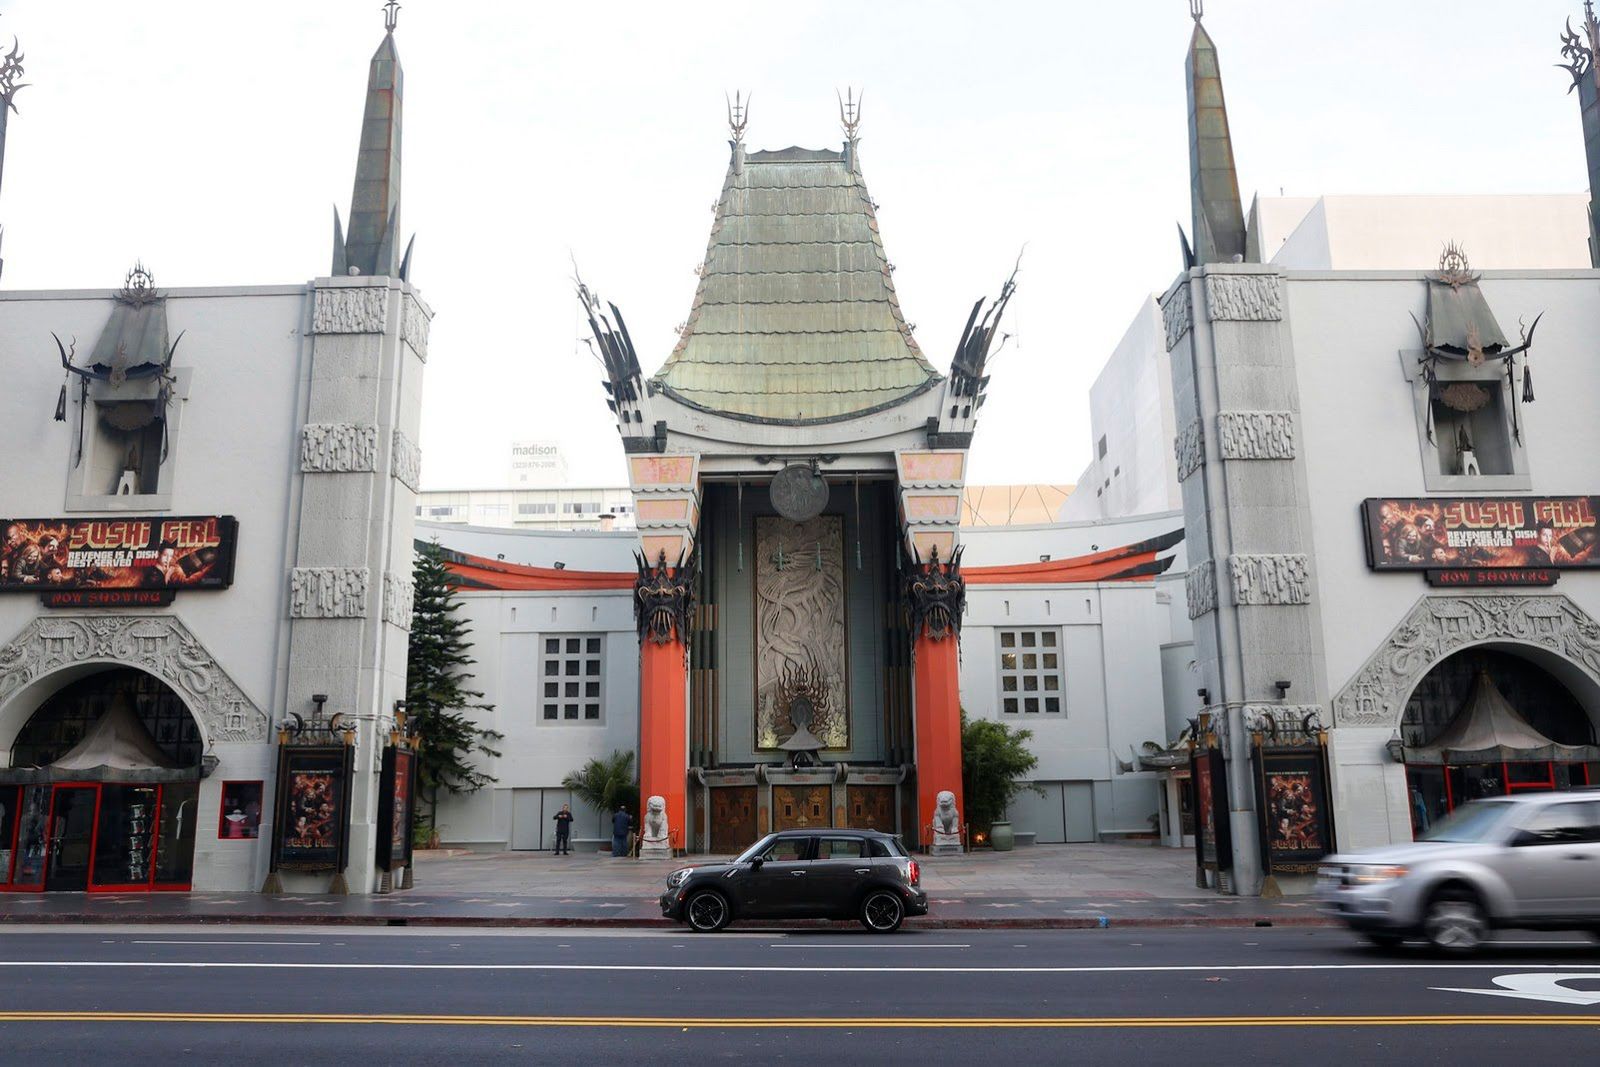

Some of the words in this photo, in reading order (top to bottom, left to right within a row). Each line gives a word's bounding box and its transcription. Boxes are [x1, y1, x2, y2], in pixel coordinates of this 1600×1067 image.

[512, 444, 557, 455] madison
[1447, 531, 1493, 540] REVENGE
[1494, 531, 1504, 540] IS
[1506, 531, 1513, 539] A
[1515, 530, 1537, 539] DISH
[1448, 538, 1472, 547] BEST
[1475, 538, 1513, 547] SERVED
[68, 551, 114, 560] REVENGE
[115, 551, 124, 559] IS
[126, 551, 133, 559] A
[136, 550, 159, 559] DISH
[67, 559, 93, 568] BEST
[95, 558, 132, 567] SERVED
[1440, 572, 1469, 583] NOW
[1477, 571, 1549, 583] SHOWING
[52, 592, 82, 604] NOW
[88, 592, 160, 603] SHOWING
